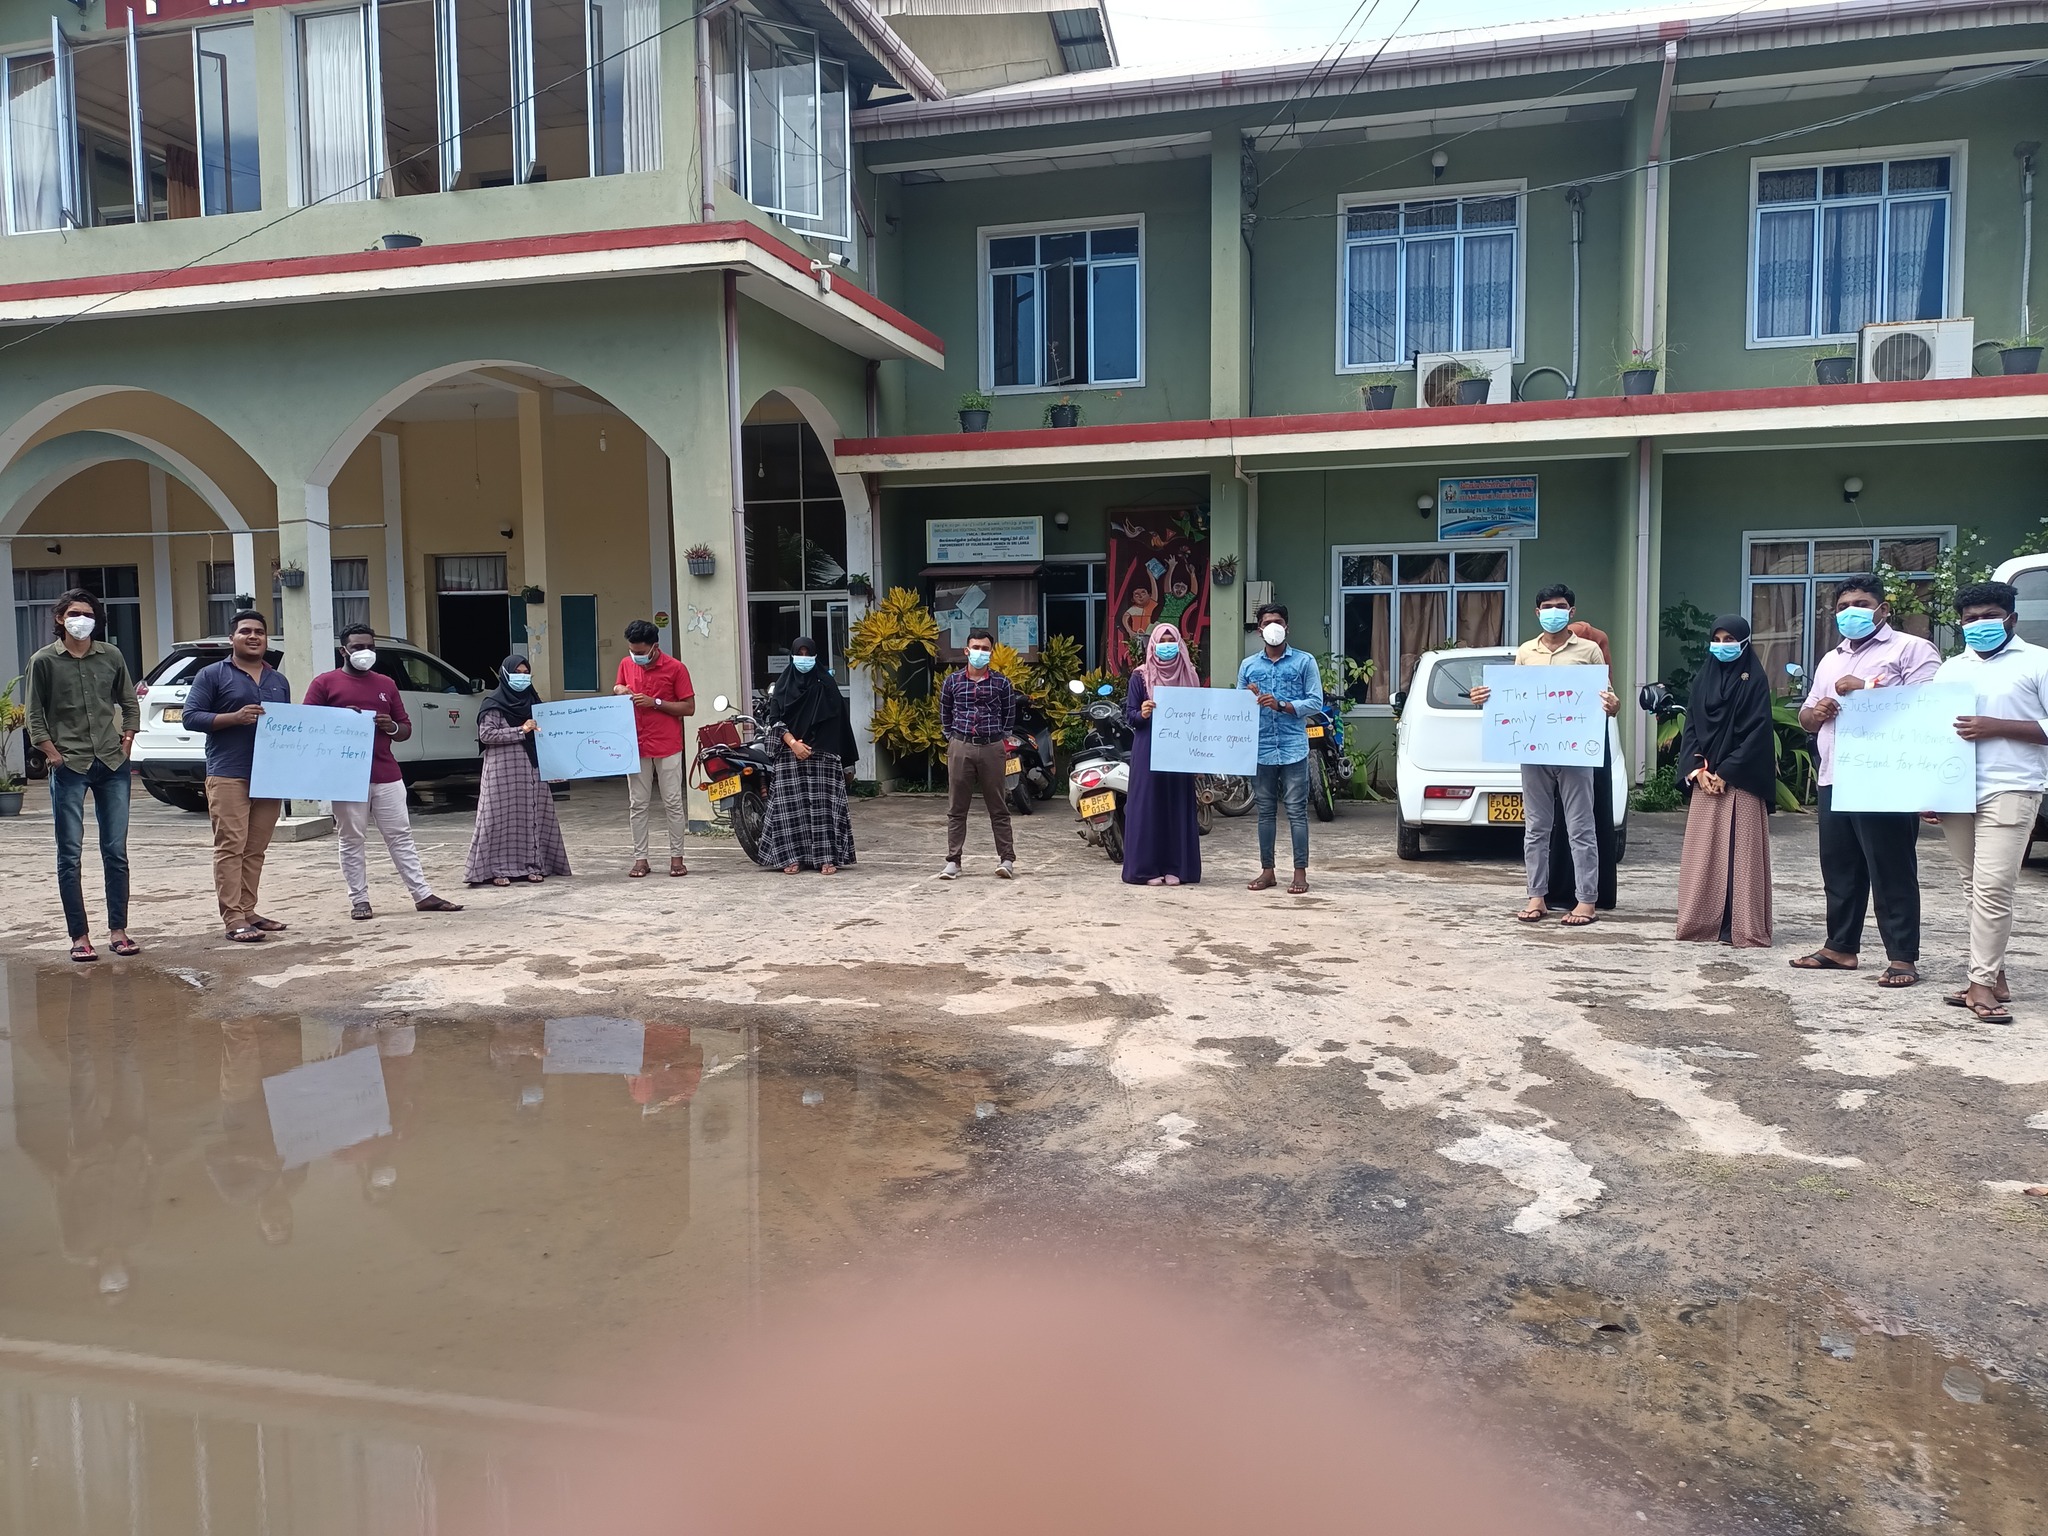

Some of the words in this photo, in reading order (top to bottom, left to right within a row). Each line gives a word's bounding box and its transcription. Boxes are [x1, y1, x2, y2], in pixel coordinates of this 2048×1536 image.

[1502, 688, 1527, 702] The
[1537, 684, 1584, 705] Happy
[1893, 693, 1910, 711] for
[1164, 707, 1196, 724] Orange
[1200, 708, 1218, 720] the
[1224, 710, 1252, 722] world
[1494, 710, 1537, 733] Family
[1546, 713, 1586, 724] Start
[265, 717, 303, 735] Respect
[309, 725, 326, 734] and
[1159, 729, 1180, 739] End
[1187, 731, 1222, 742] Violence
[1508, 731, 1549, 755] from
[316, 743, 334, 757] for
[1189, 748, 1215, 758] Women
[1896, 752, 1912, 770] for
[1917, 755, 1938, 772] Her
[718, 778, 736, 789] BAG
